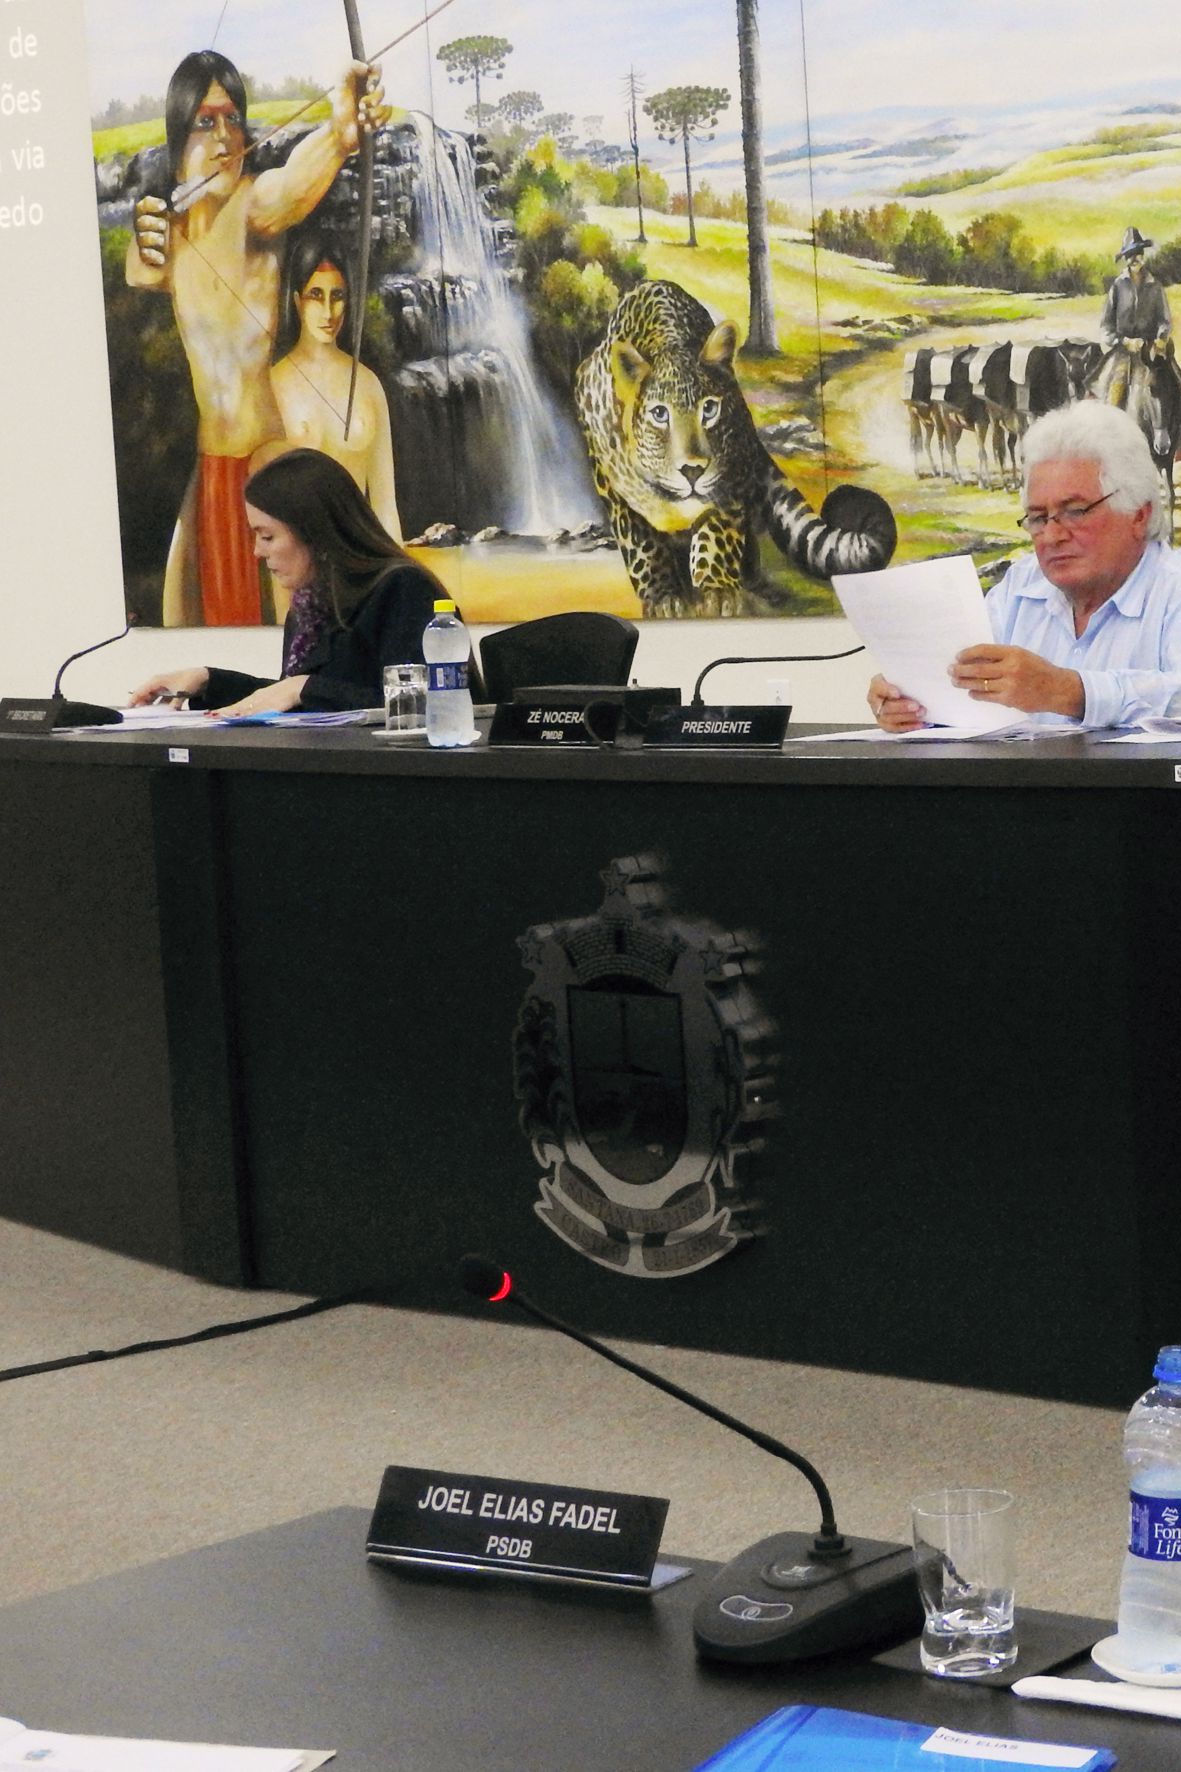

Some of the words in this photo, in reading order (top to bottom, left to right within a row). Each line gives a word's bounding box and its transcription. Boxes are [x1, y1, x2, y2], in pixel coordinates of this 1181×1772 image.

[9, 26, 38, 59] de
[11, 139, 45, 171] via
[527, 710, 542, 724] ZÉ
[543, 711, 586, 724] NOCERA
[681, 720, 753, 735] PRESIDENTE
[540, 730, 564, 740] PMDB
[418, 1485, 474, 1515] JOEL
[479, 1492, 545, 1524] ELIAS
[548, 1501, 621, 1534] FADEL
[485, 1535, 533, 1559] PSDB
[934, 1732, 970, 1745] JOEL
[975, 1739, 1019, 1751] ELIAS
